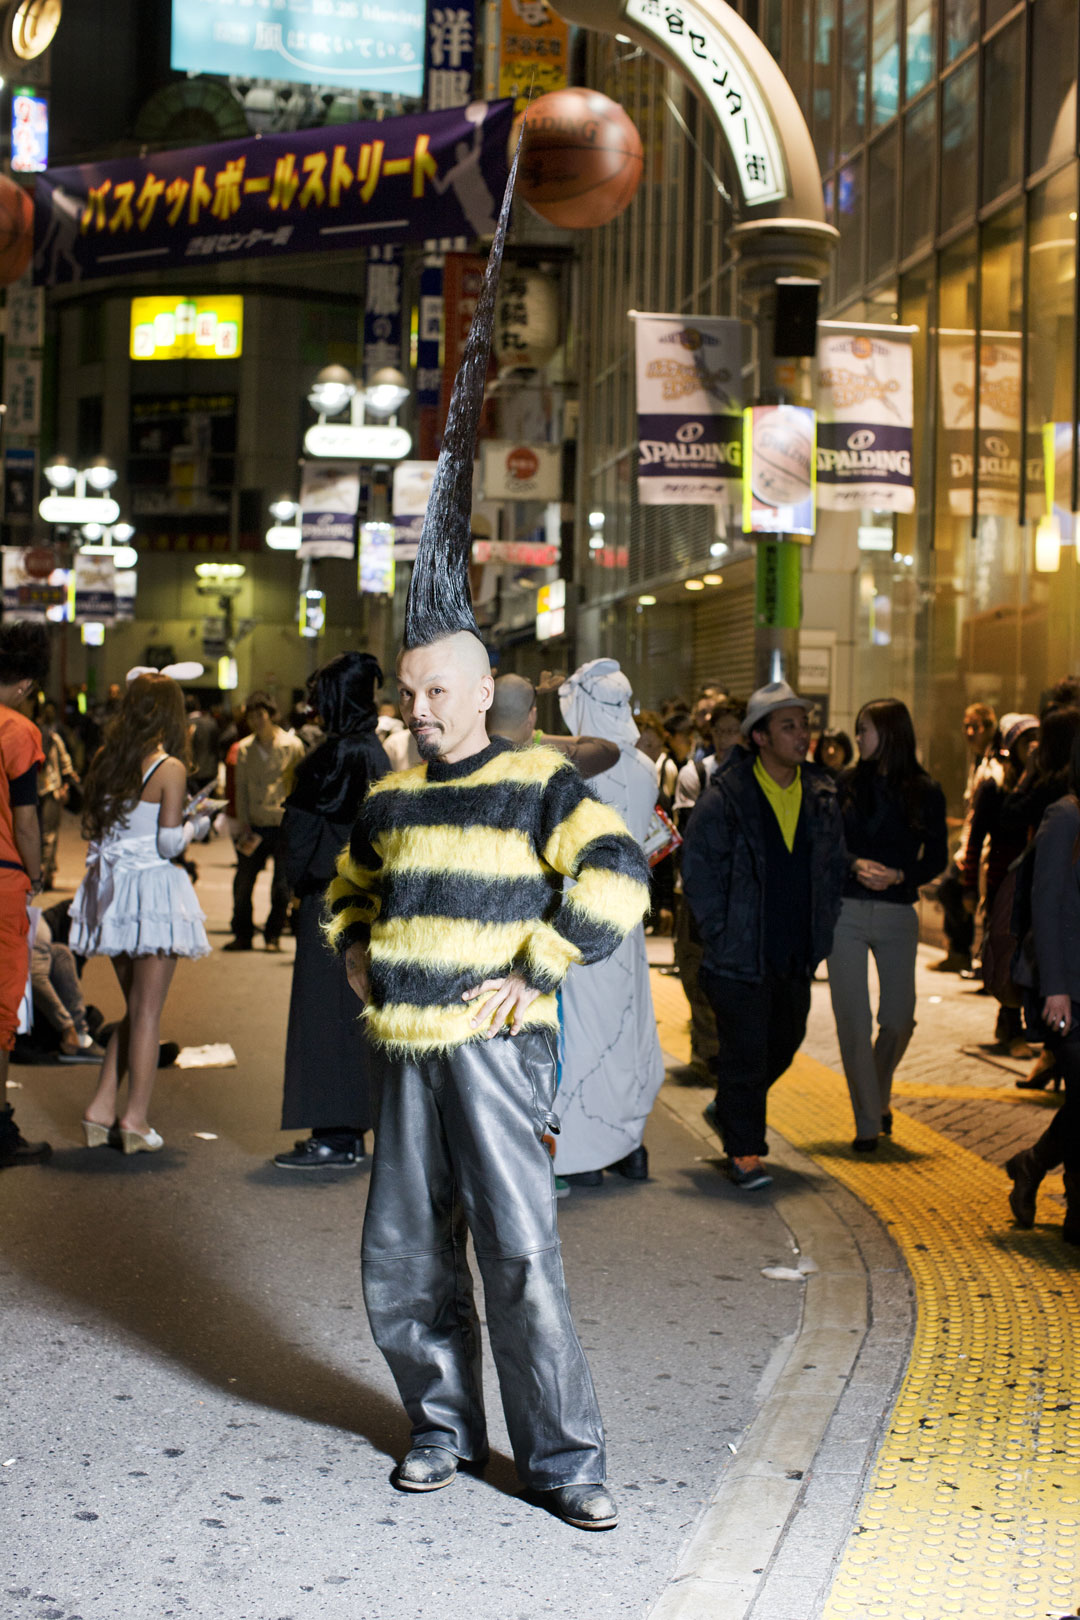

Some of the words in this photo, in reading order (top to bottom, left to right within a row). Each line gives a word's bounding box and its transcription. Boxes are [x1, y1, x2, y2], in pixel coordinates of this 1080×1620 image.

[80, 134, 438, 235] バスケットボールストリート
[639, 440, 742, 466] SPALDING
